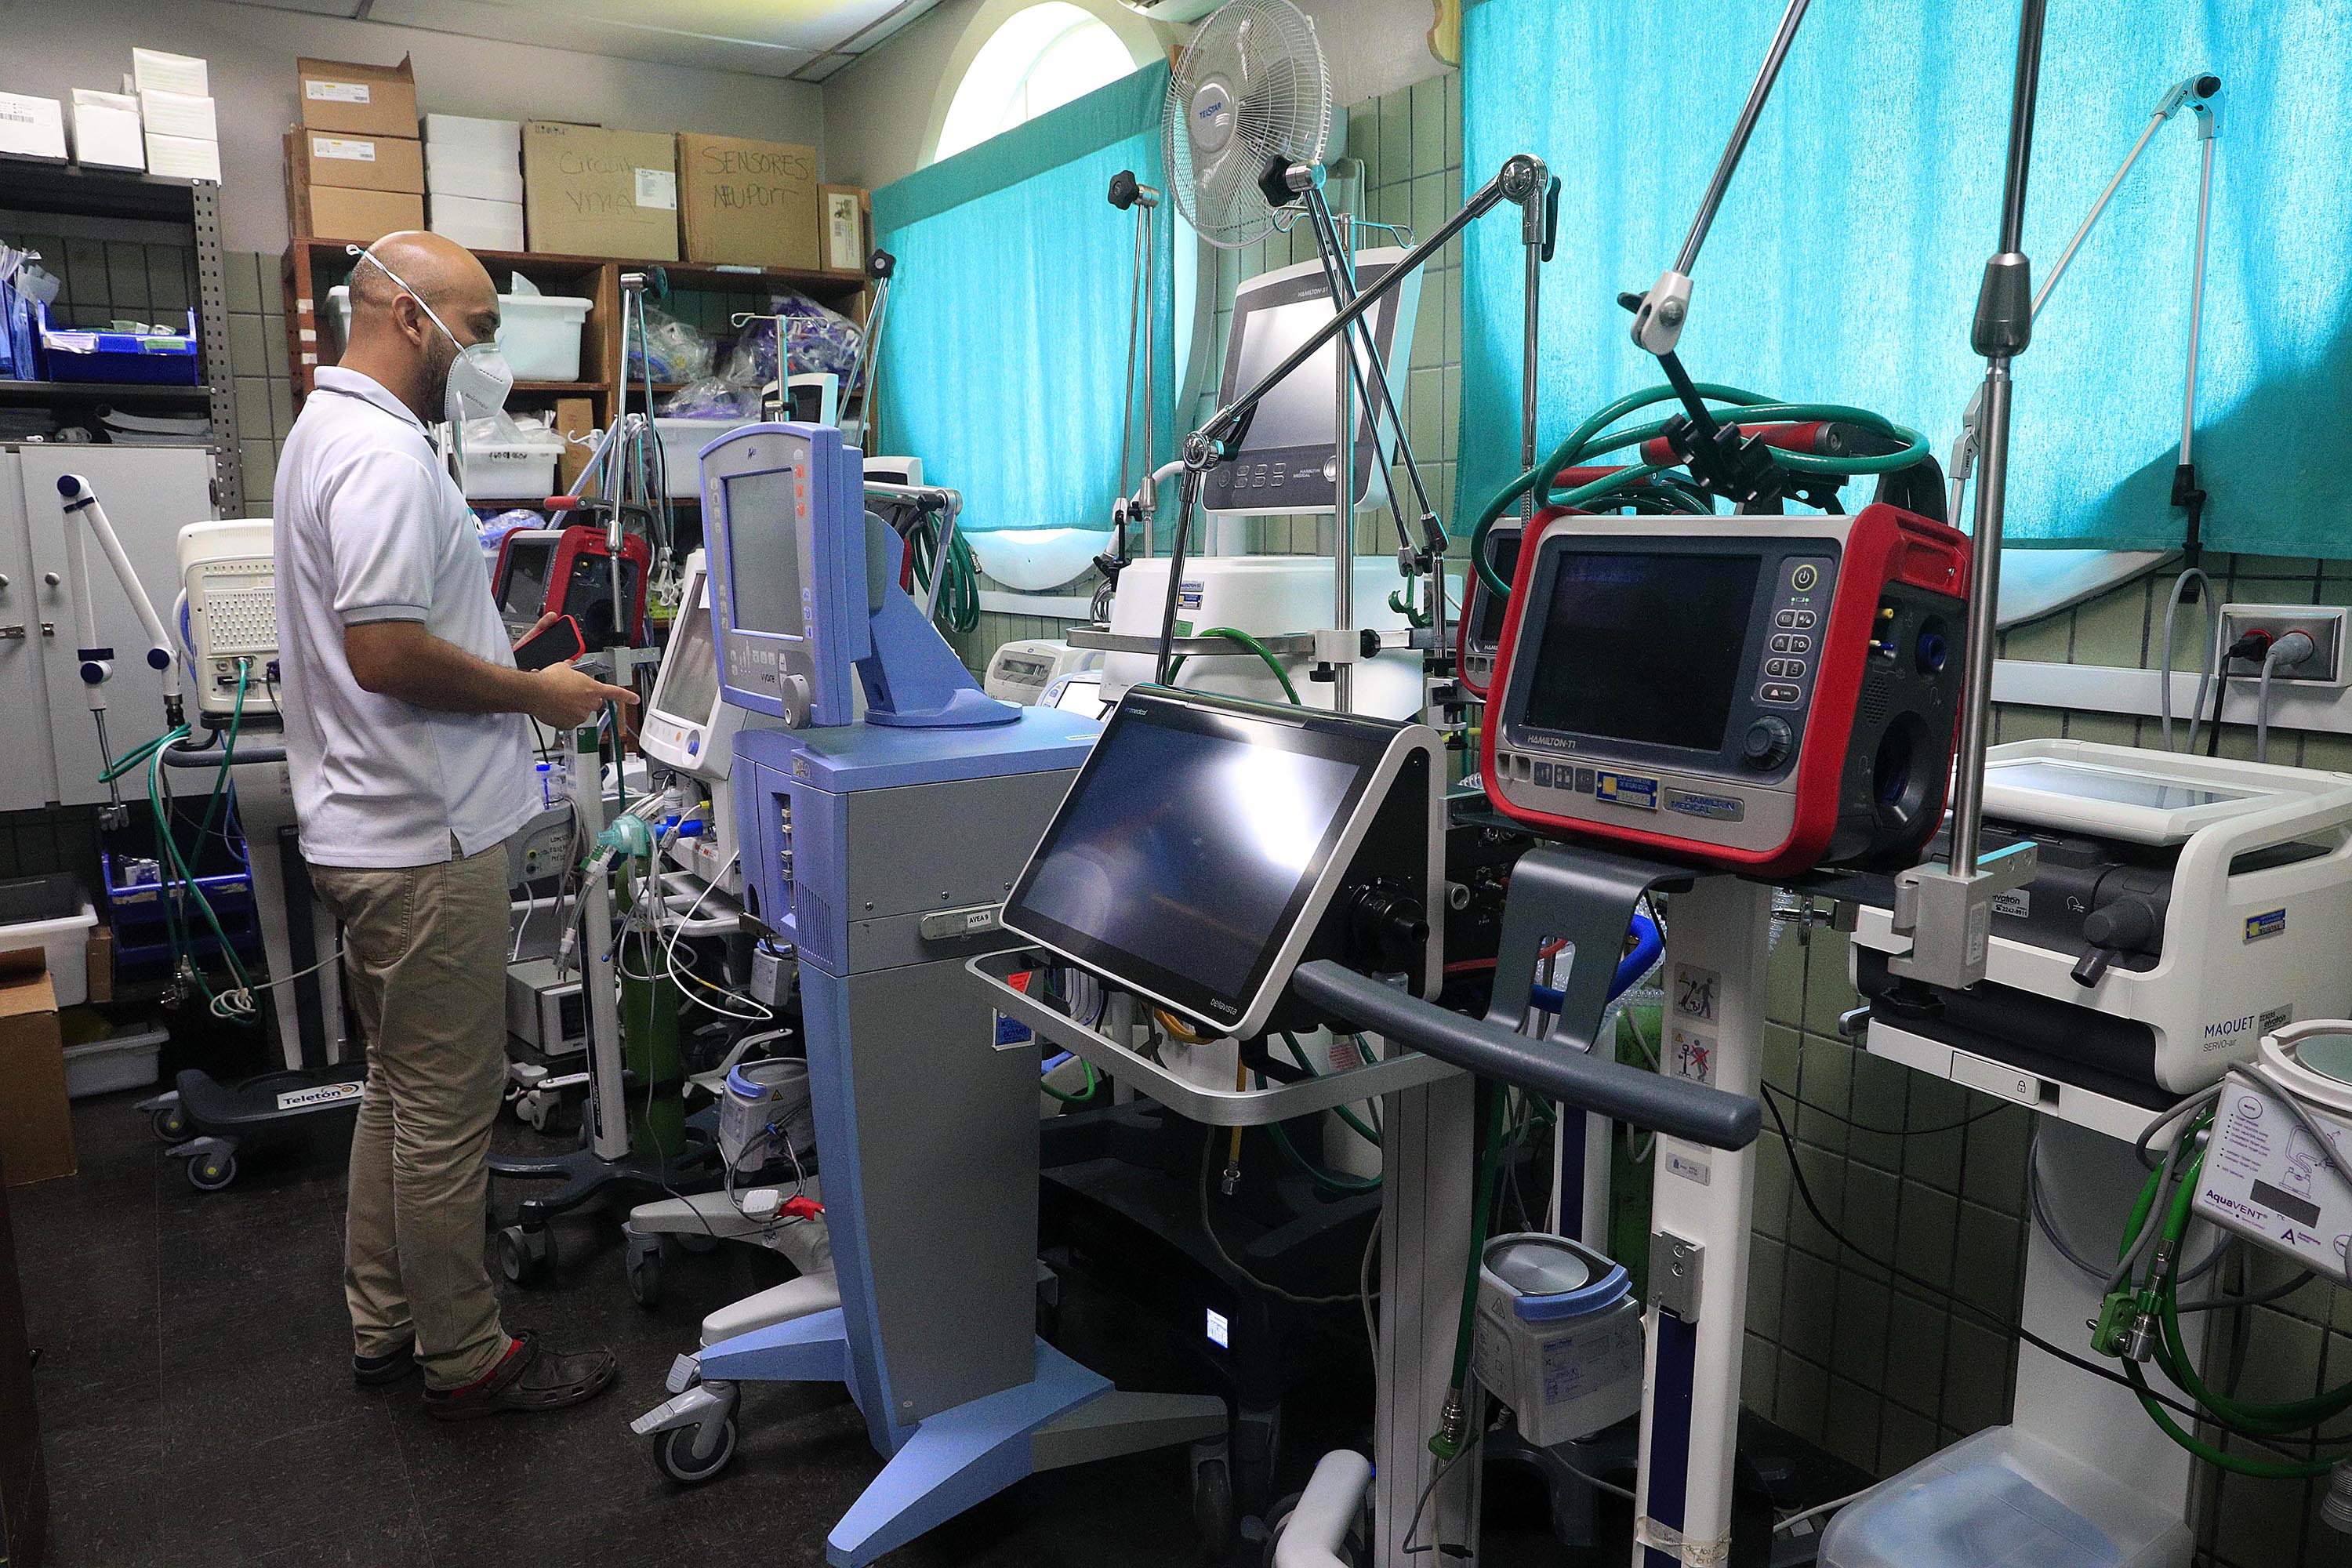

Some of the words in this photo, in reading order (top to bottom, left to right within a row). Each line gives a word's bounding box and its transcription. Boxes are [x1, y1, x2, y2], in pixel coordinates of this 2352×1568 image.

[1200, 102, 1221, 119] TELSTAR
[702, 146, 808, 180] SENSORES
[1671, 800, 1711, 815] MEDICAL
[1686, 795, 1735, 811] HAMILTON
[969, 915, 985, 924] AVEA
[1210, 998, 1238, 1015] bellavista
[2204, 1014, 2255, 1039] MAQUET
[2202, 1039, 2238, 1052] SERVO-air
[283, 1091, 341, 1105] Teletón
